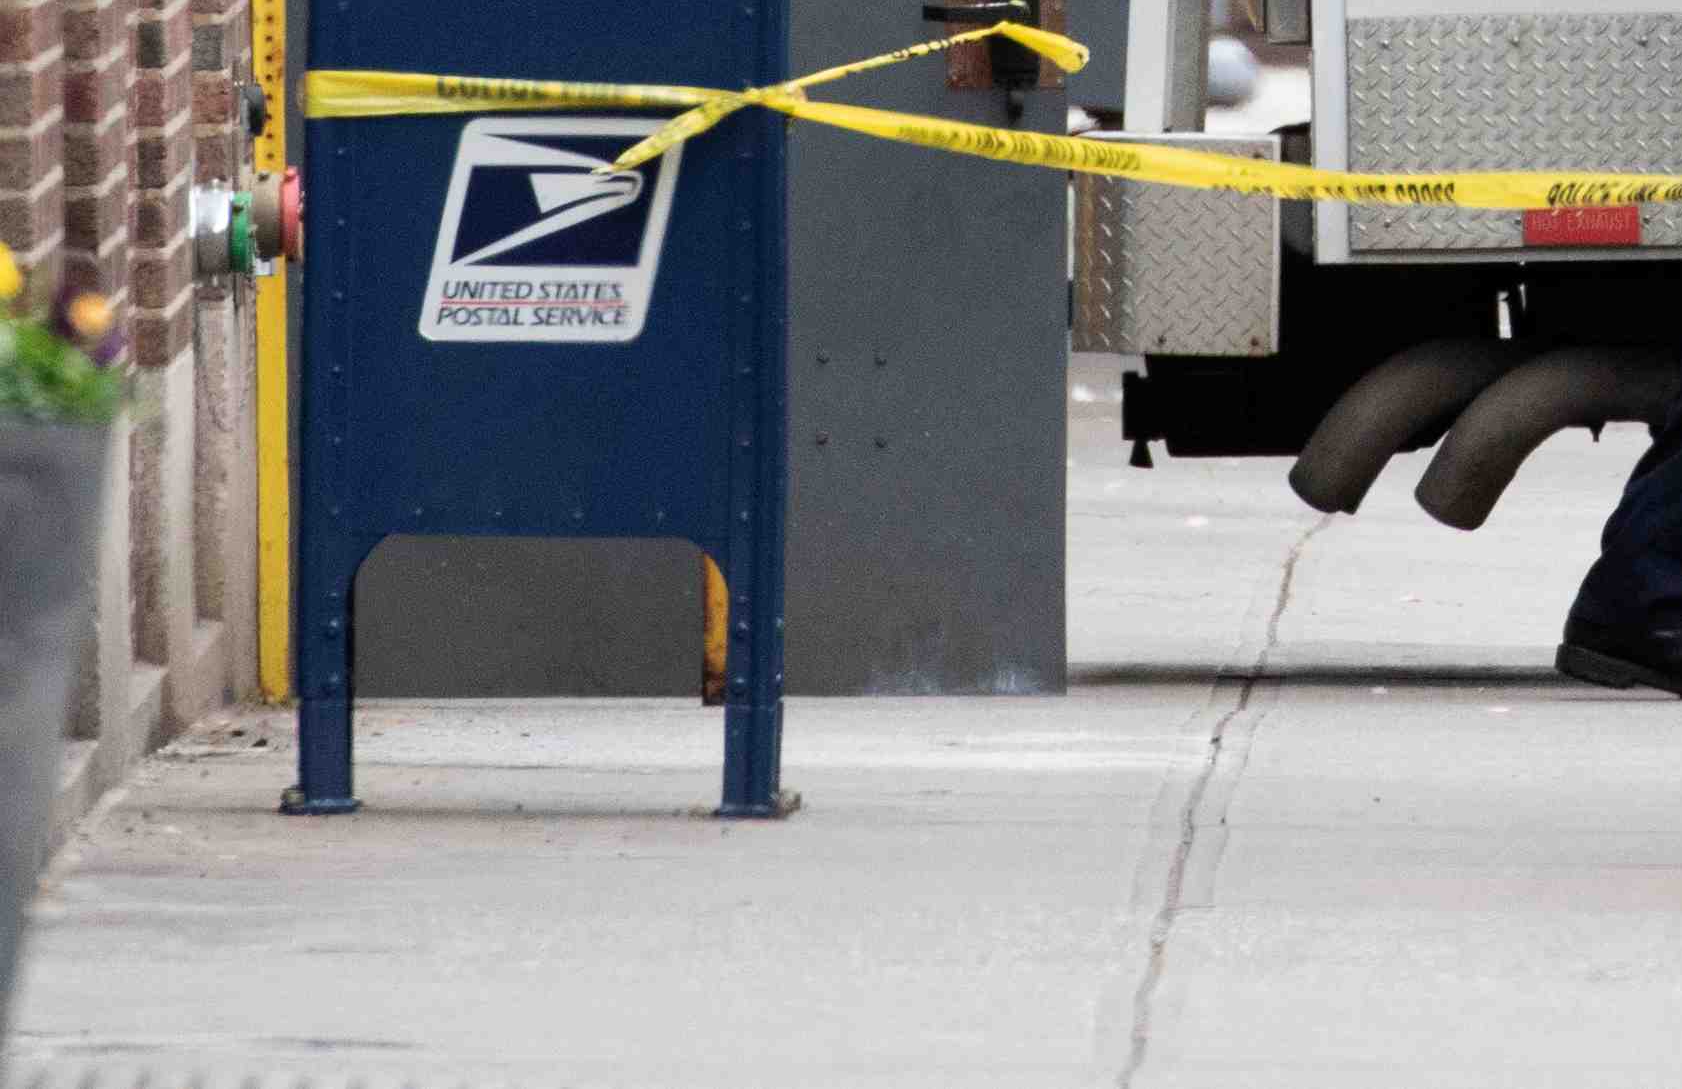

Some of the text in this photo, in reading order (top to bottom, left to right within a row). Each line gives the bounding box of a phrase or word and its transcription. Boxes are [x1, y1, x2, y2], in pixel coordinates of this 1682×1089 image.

[441, 281, 624, 301] UNITED STATES
[436, 305, 630, 327] POSTAL SERVICE
